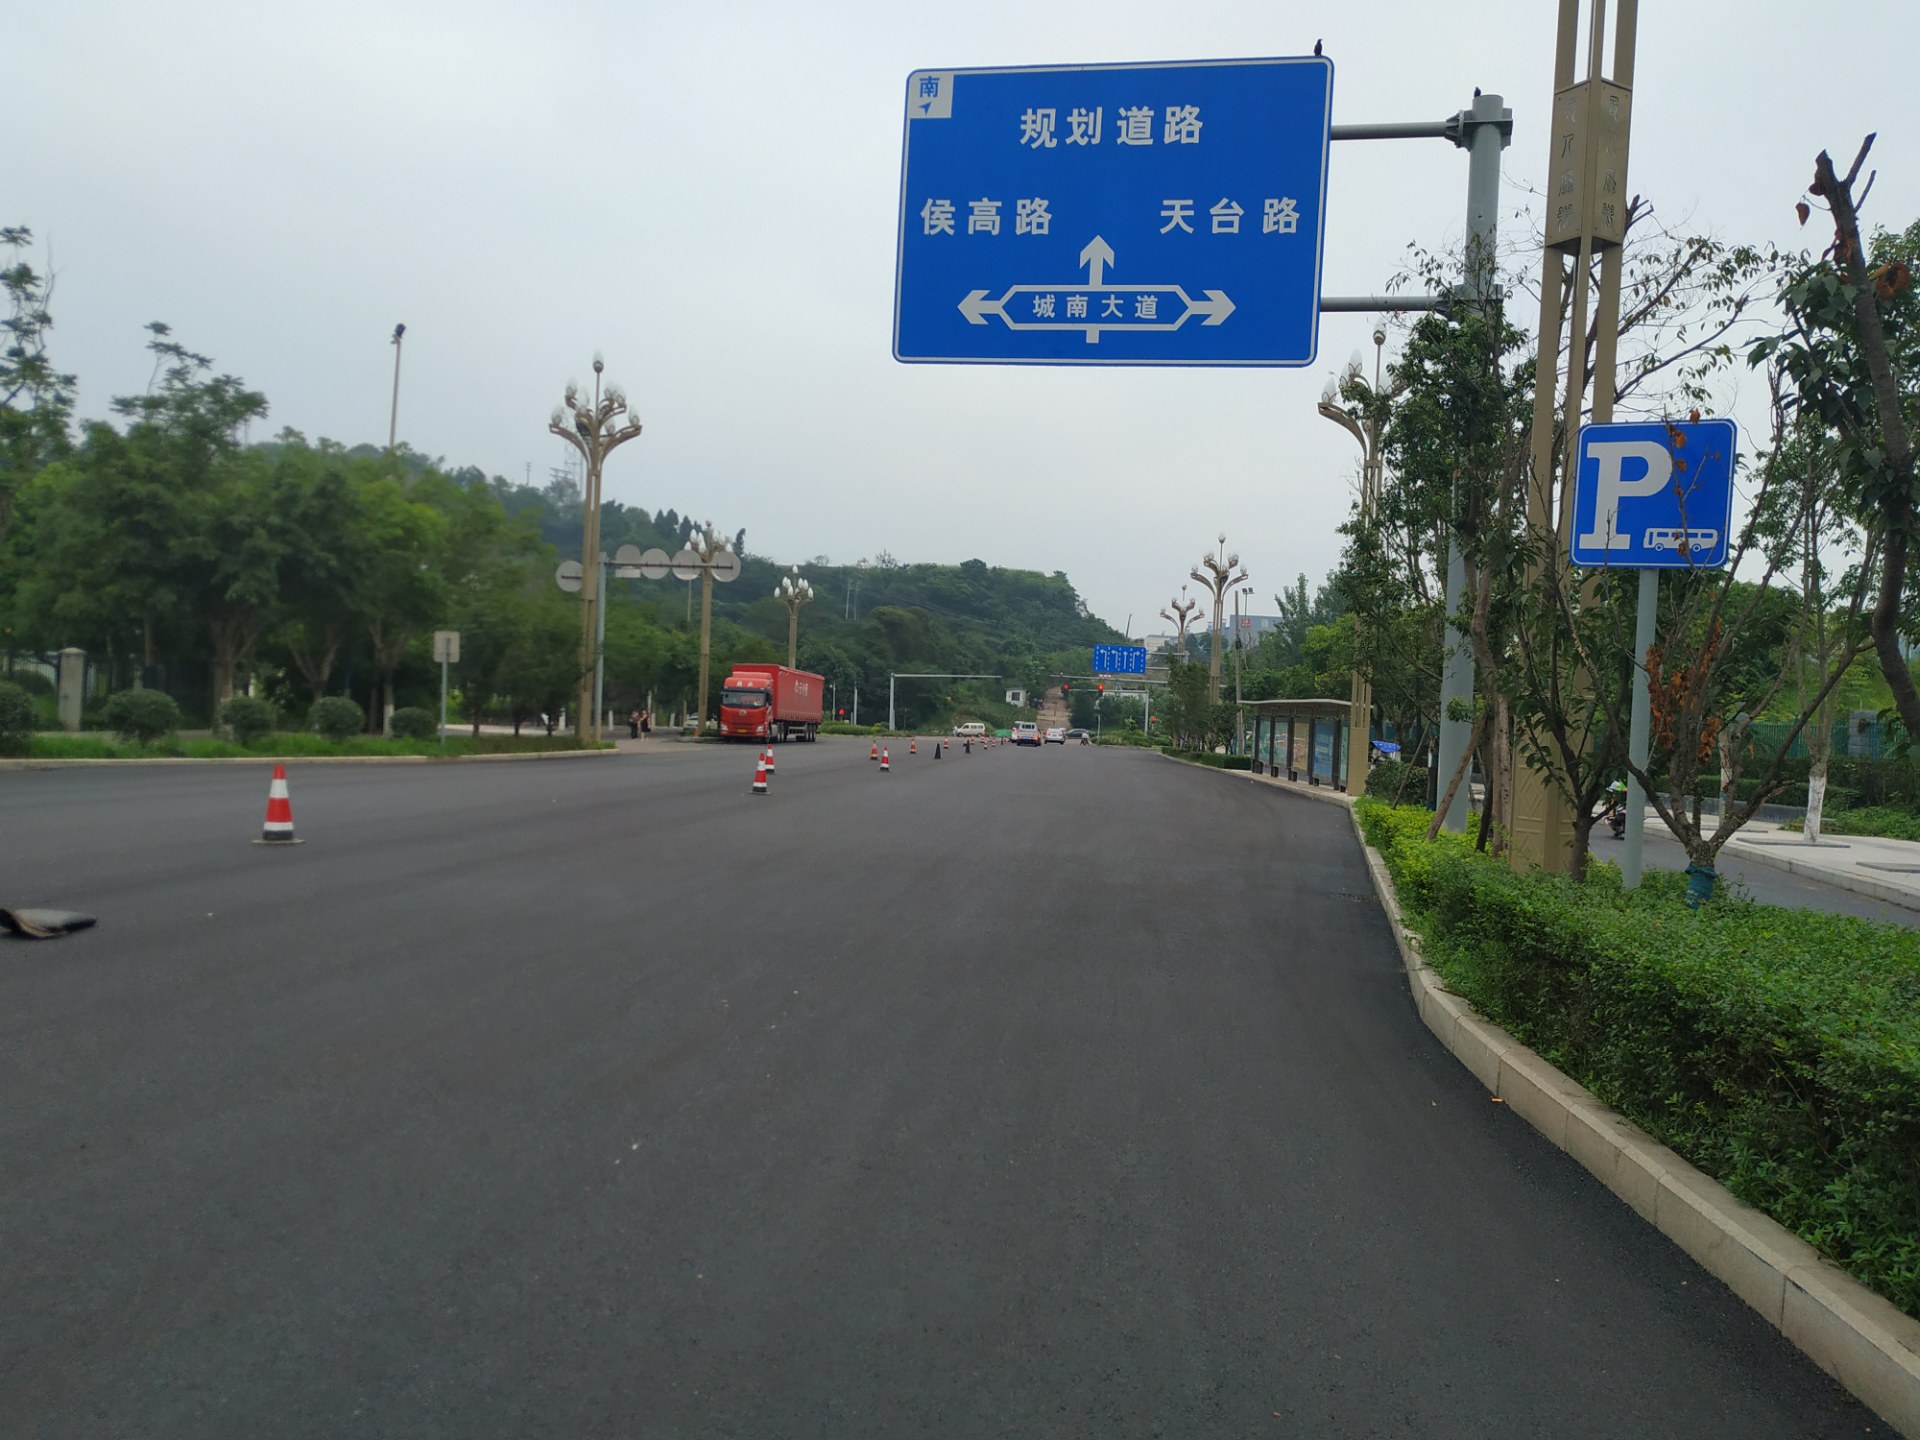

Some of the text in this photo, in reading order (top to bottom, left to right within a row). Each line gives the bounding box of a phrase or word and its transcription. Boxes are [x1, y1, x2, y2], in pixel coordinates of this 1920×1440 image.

[919, 75, 940, 98] 南
[1019, 104, 1204, 149] 规划道路
[920, 197, 1053, 236] 侯高路
[1160, 197, 1301, 235] 天台路
[1032, 293, 1159, 319] 城南大道
[1579, 440, 1673, 550] P
